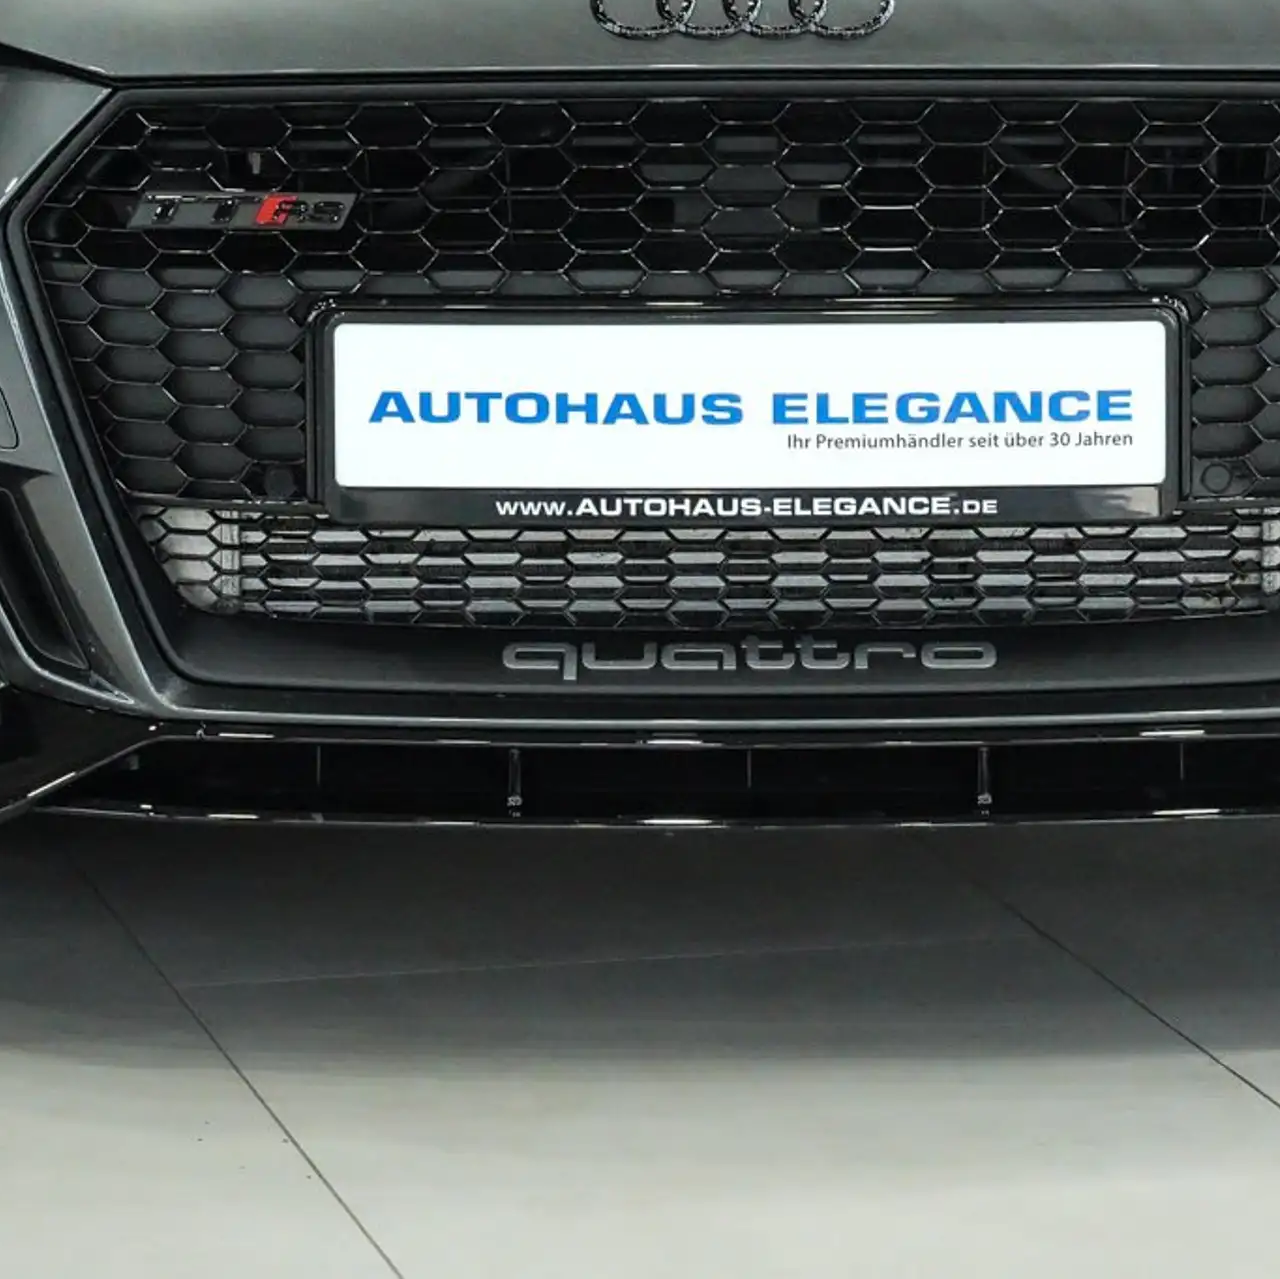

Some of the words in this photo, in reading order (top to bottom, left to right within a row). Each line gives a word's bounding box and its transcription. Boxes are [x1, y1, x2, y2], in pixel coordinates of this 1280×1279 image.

[368, 390, 744, 426] AUTOHAUS
[772, 389, 1133, 426] ELEGANCE
[787, 433, 811, 449] Ihr
[815, 432, 965, 450] Premiumhändler
[968, 432, 1000, 449] seit
[1003, 431, 1045, 449] über
[1049, 430, 1071, 447] 30
[1074, 430, 1133, 447] Jahren
[502, 635, 998, 682] quattro
